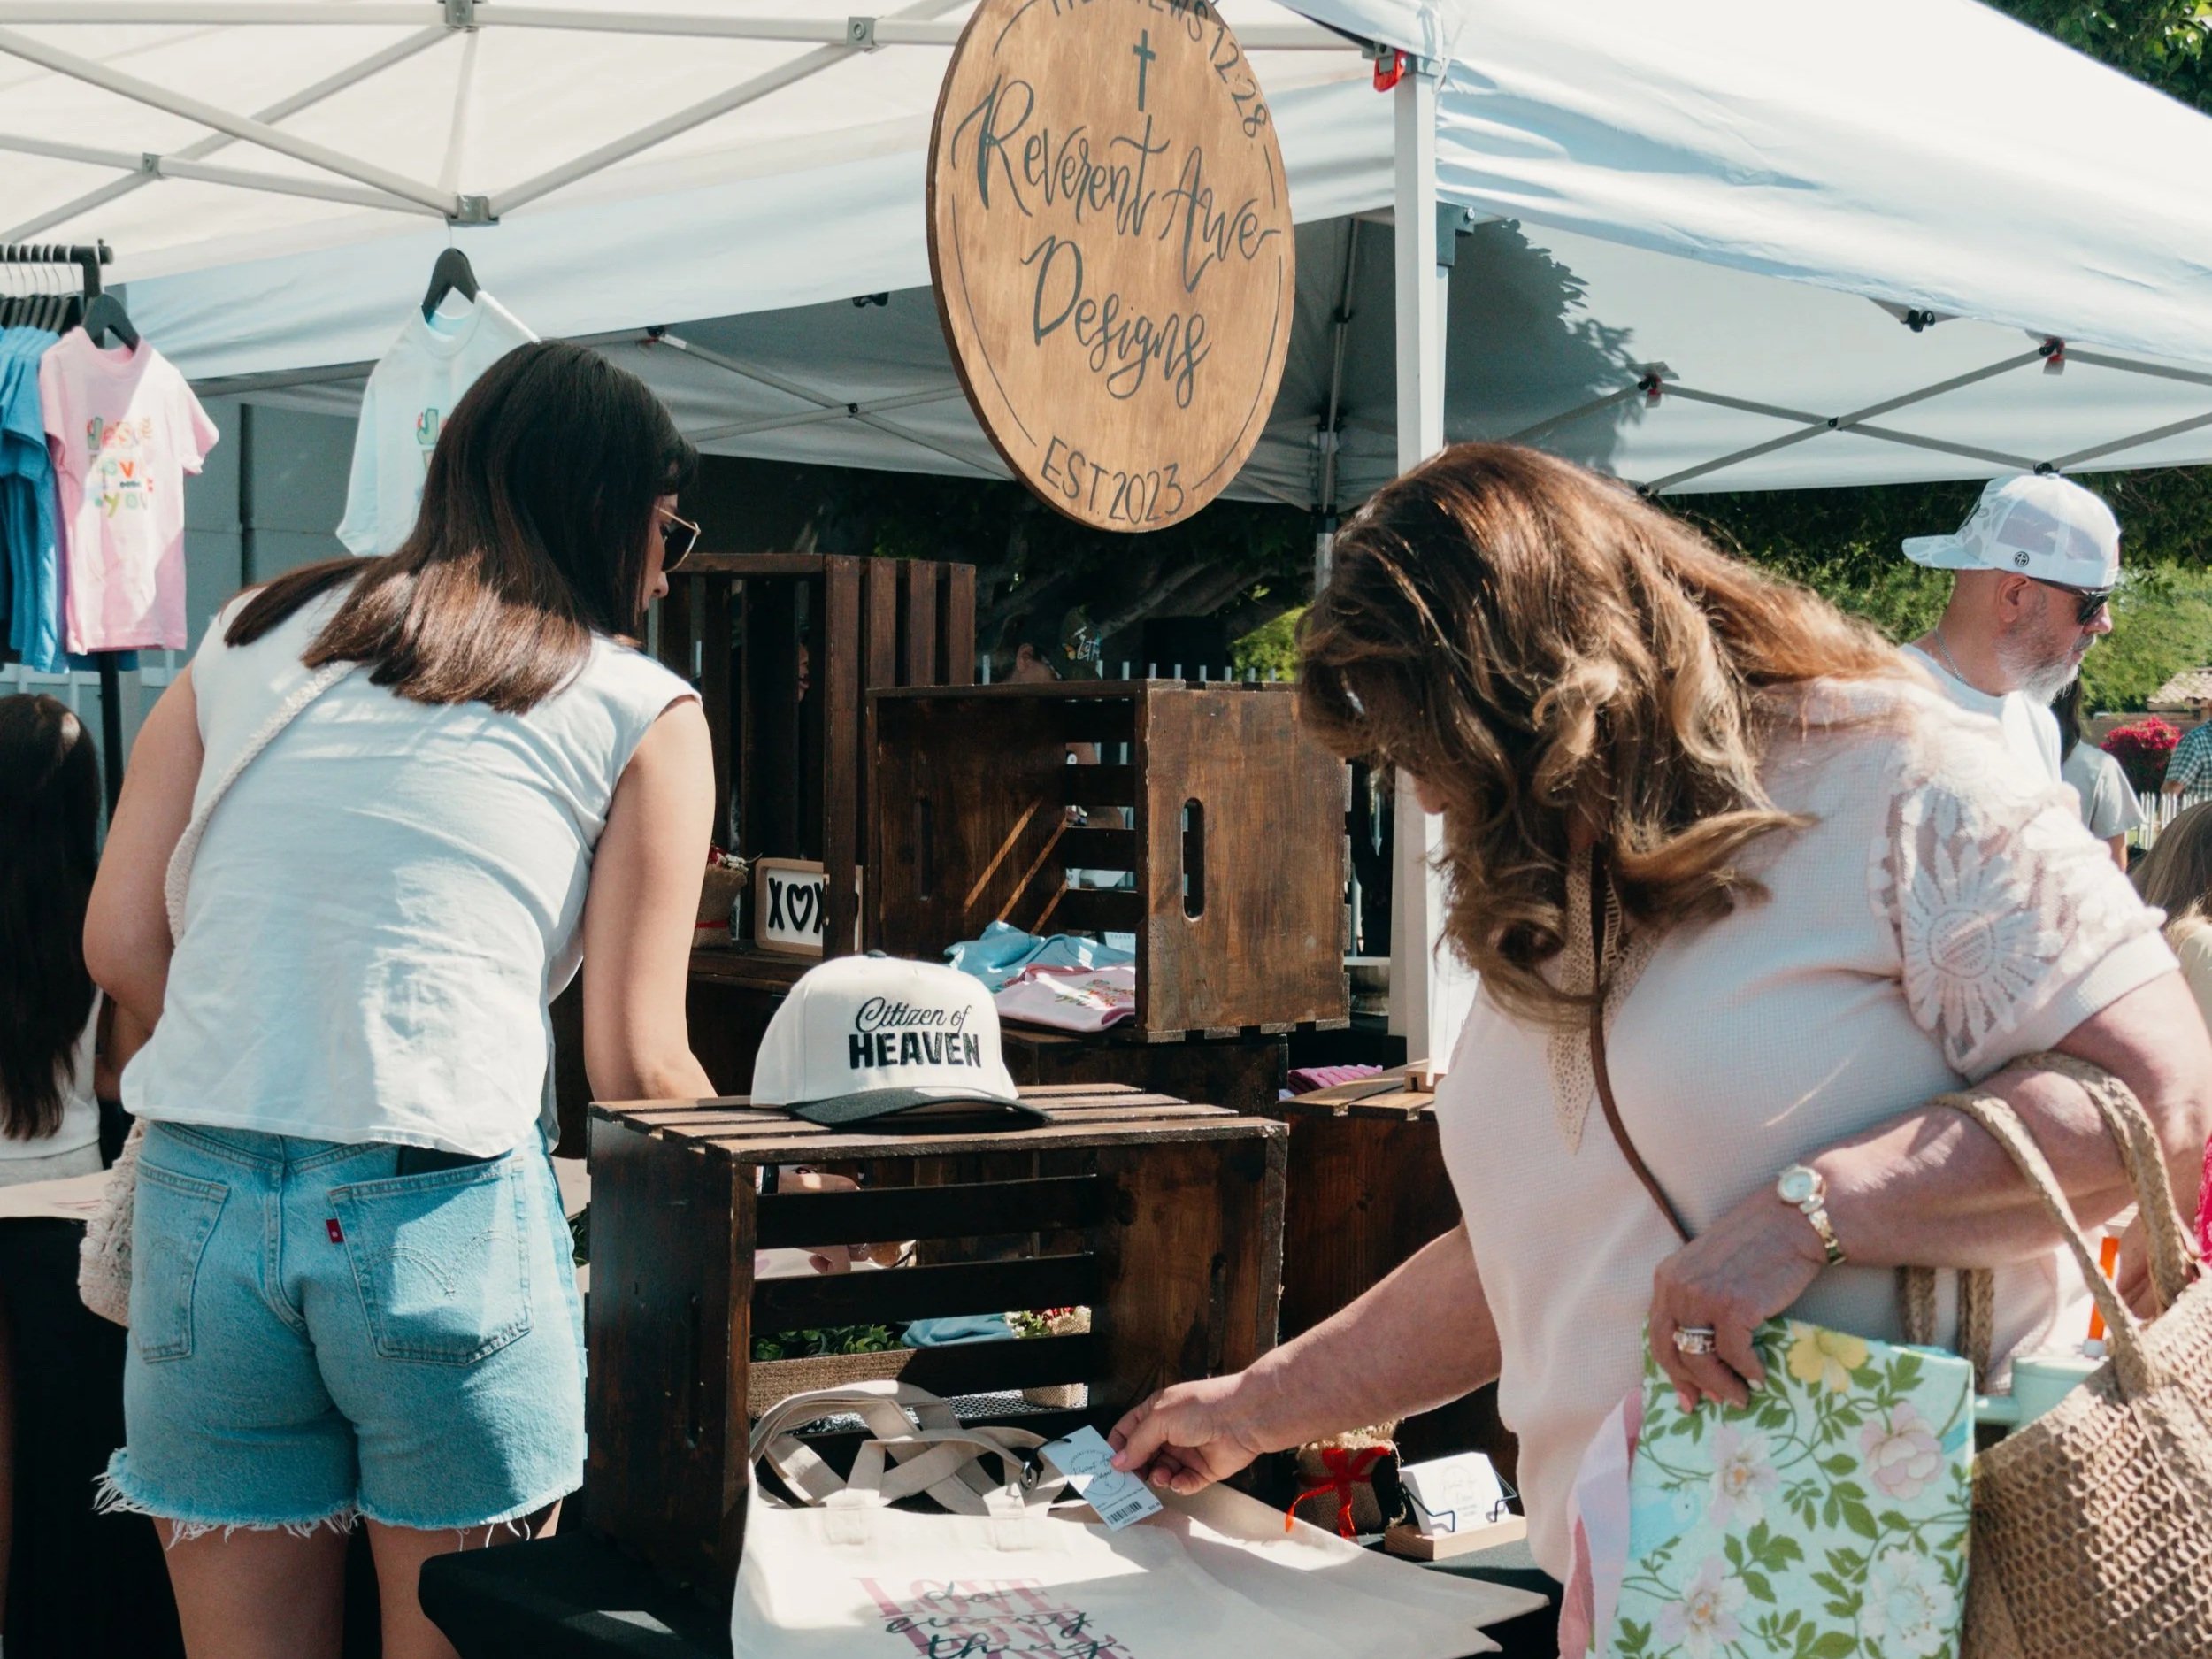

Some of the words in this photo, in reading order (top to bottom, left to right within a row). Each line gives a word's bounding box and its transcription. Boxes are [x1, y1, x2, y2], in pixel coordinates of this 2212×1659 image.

[952, 74, 1170, 236] Reverent
[1158, 146, 1281, 293] Awe
[1020, 235, 1212, 409] Designs
[856, 996, 947, 1033] Citizen
[950, 1005, 972, 1034] of
[849, 1031, 981, 1070] HEAVEN
[851, 1578, 1081, 1618] LOVE
